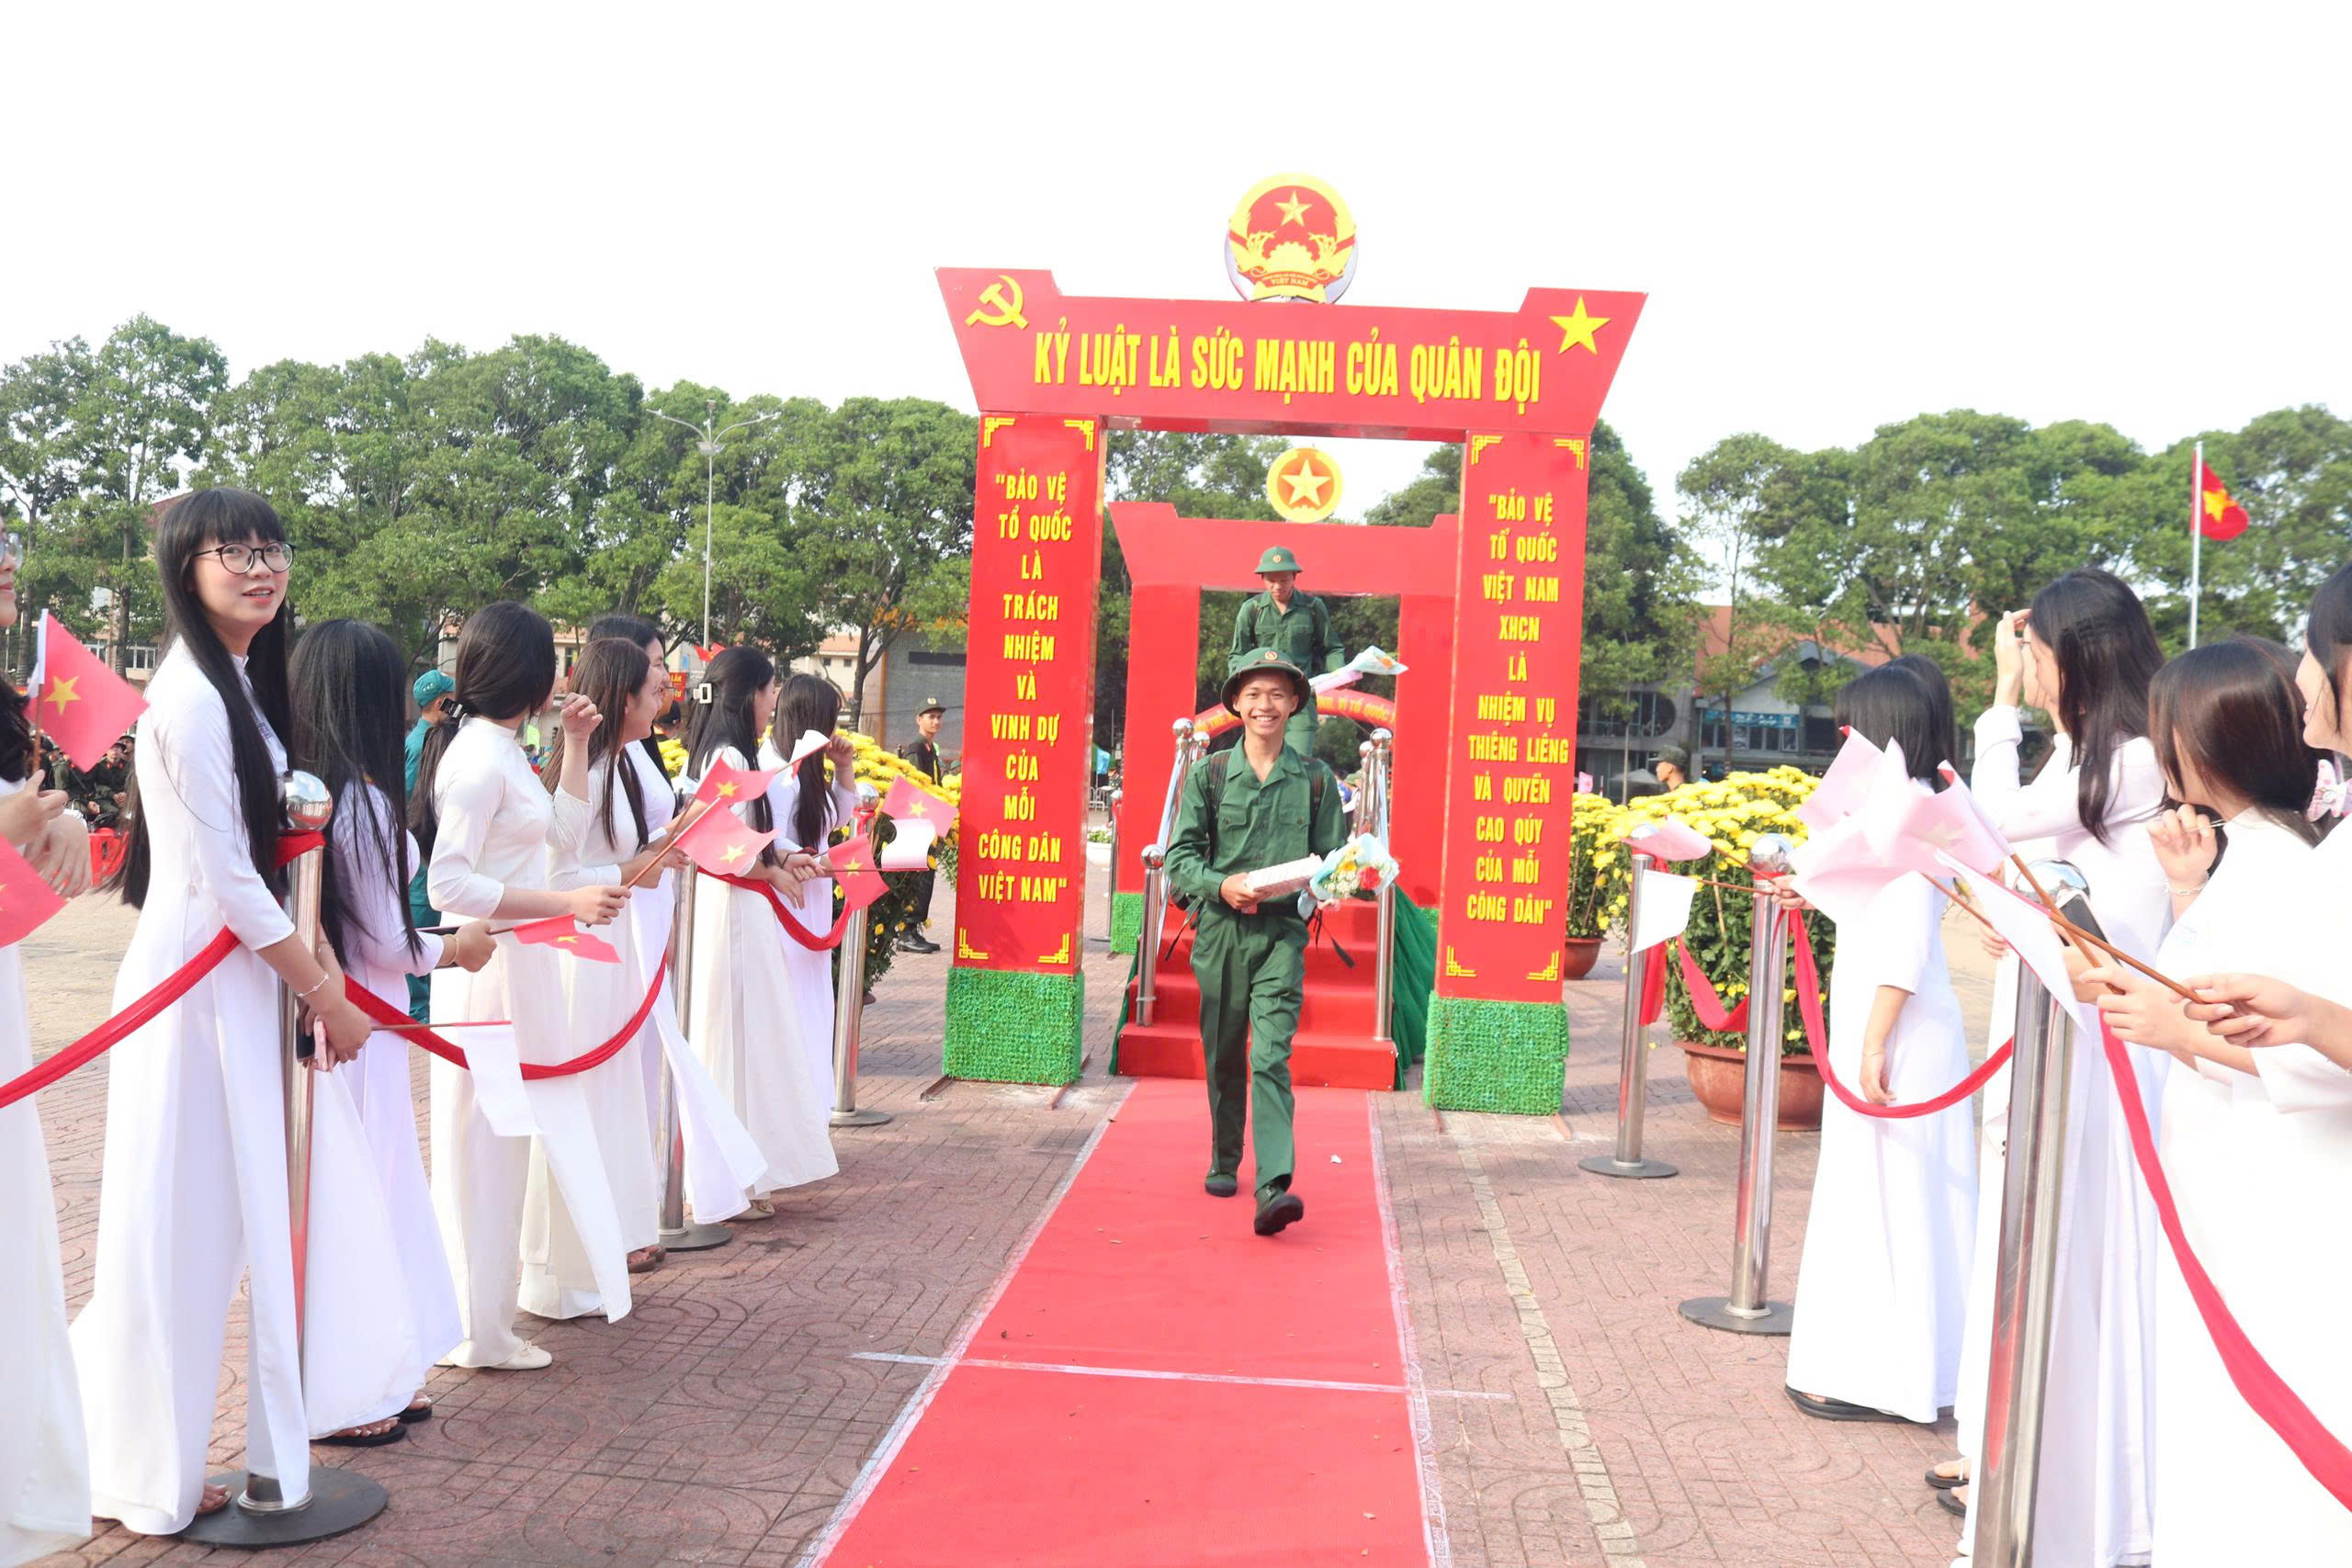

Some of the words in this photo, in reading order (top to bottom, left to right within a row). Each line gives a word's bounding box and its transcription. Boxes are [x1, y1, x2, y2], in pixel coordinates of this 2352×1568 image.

[1034, 316, 1071, 384] KỶ
[1079, 323, 1142, 396] LUẬT
[1148, 325, 1182, 389] LÀ
[1191, 325, 1245, 390] SỨC
[1254, 338, 1336, 405] MẠNH
[1346, 326, 1399, 396] CỦA
[1409, 335, 1484, 404] QUÂN
[1494, 338, 1542, 415] ĐỘI
[995, 468, 1038, 501] "BẢO
[1046, 471, 1068, 506] VỆ
[999, 505, 1020, 539] TỔ
[1029, 509, 1072, 542] QUỐC
[1533, 492, 1554, 527] VỆ
[1489, 528, 1510, 560] TỔ
[1515, 531, 1558, 564] QUỐC
[1021, 549, 1043, 581] LÀ
[1482, 570, 1515, 604] VIỆT
[1524, 576, 1559, 603] NAM
[1002, 590, 1058, 621] TRÁCH
[1498, 615, 1540, 642] XHCN
[1003, 630, 1055, 665] NHIỆM
[1508, 650, 1528, 682] LÀ
[1016, 671, 1037, 700] VÀ
[1477, 691, 1527, 727] NHIỆM
[1535, 697, 1555, 728] VỤ
[990, 714, 1031, 741] VINH
[1036, 713, 1060, 747] DỰ
[1467, 730, 1519, 762] THIÊNG
[1525, 733, 1569, 764] LIÊNG
[1005, 750, 1039, 781] CỦA
[1003, 786, 1035, 820] MỖI
[1474, 771, 1492, 802] VÀ
[1503, 773, 1551, 805] QUYỀN
[978, 829, 1022, 861] CÔNG
[1027, 831, 1061, 863] DÂN
[1476, 815, 1505, 842] CAO
[1513, 813, 1544, 846] QÚY
[1476, 849, 1503, 883] CỦA
[1512, 849, 1540, 884] MỖI
[978, 871, 1015, 904] VIỆT
[1020, 877, 1068, 903] NAM"
[1466, 889, 1508, 922] CÔNG
[1513, 893, 1553, 925] DÂN"
